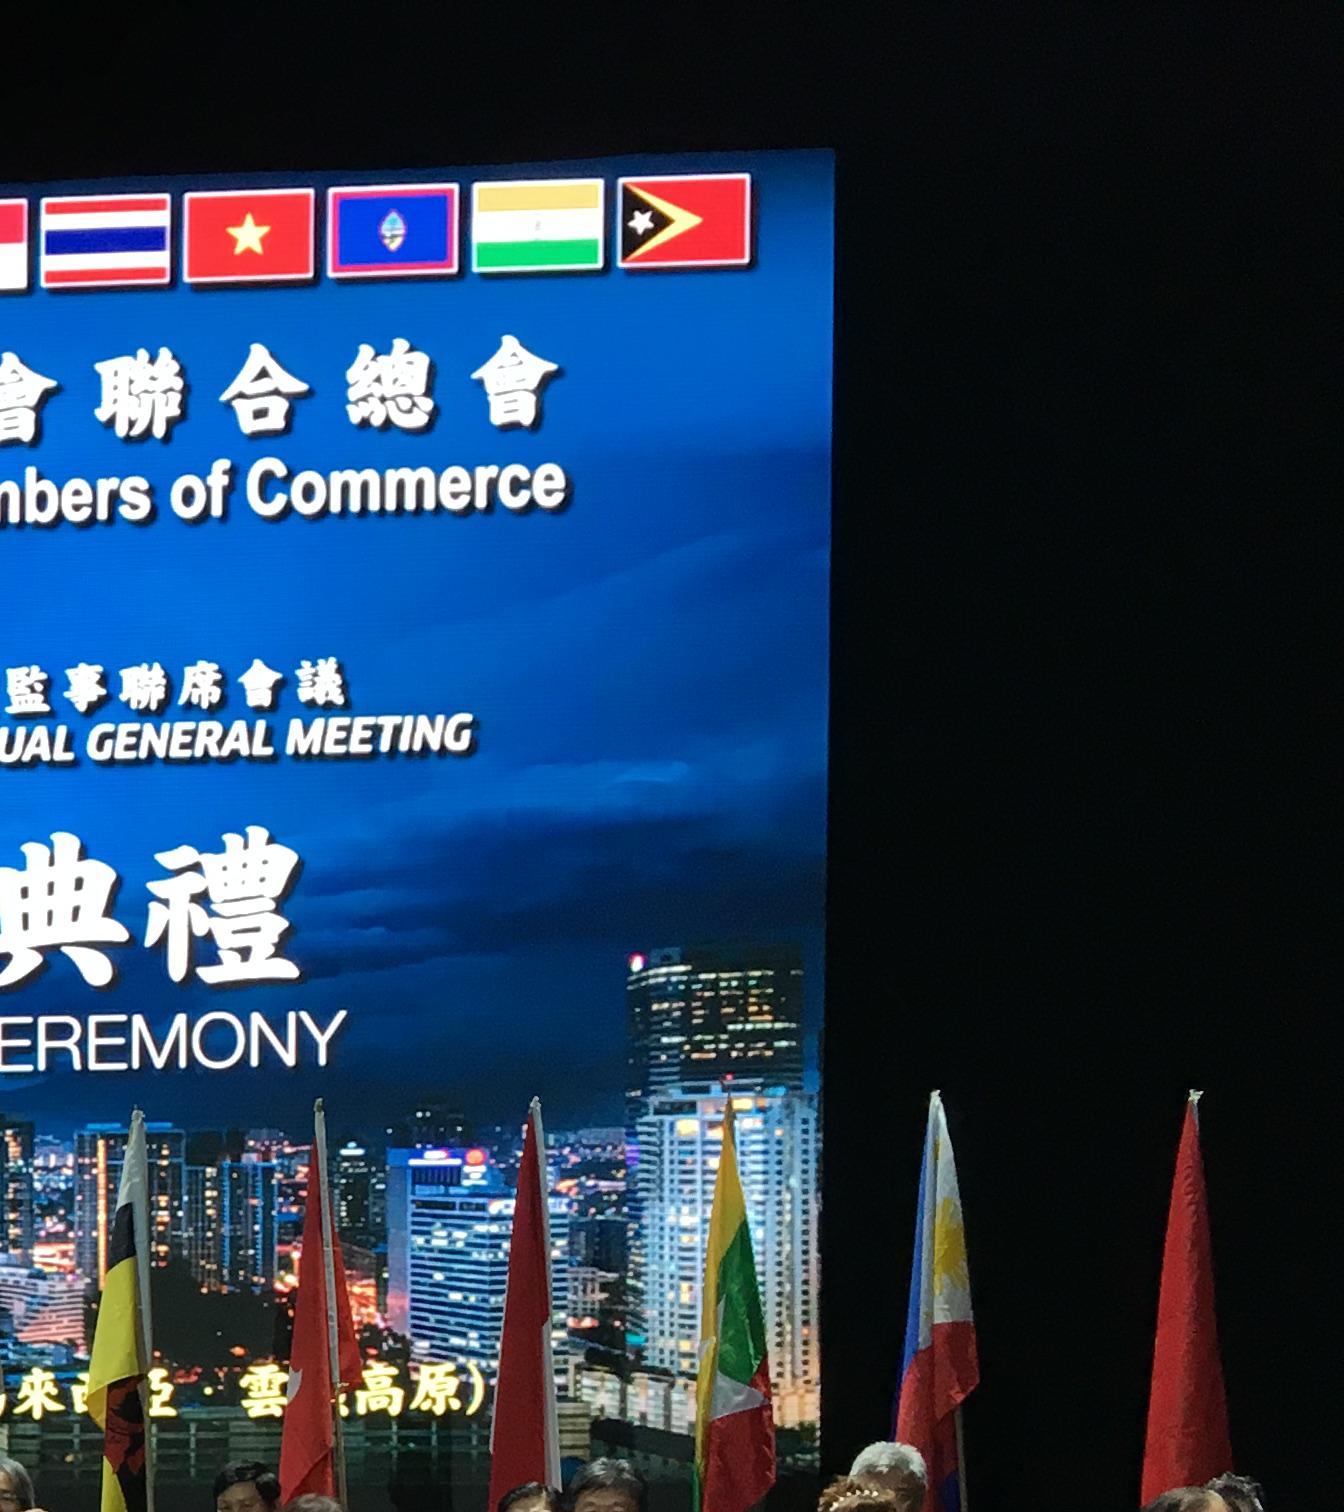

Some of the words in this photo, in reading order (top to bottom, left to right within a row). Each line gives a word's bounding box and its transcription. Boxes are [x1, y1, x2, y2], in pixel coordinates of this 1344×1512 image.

[170, 459, 231, 518] of
[246, 457, 567, 517] Commerce
[87, 718, 274, 762] GENERAL
[285, 713, 474, 755] MEETING
